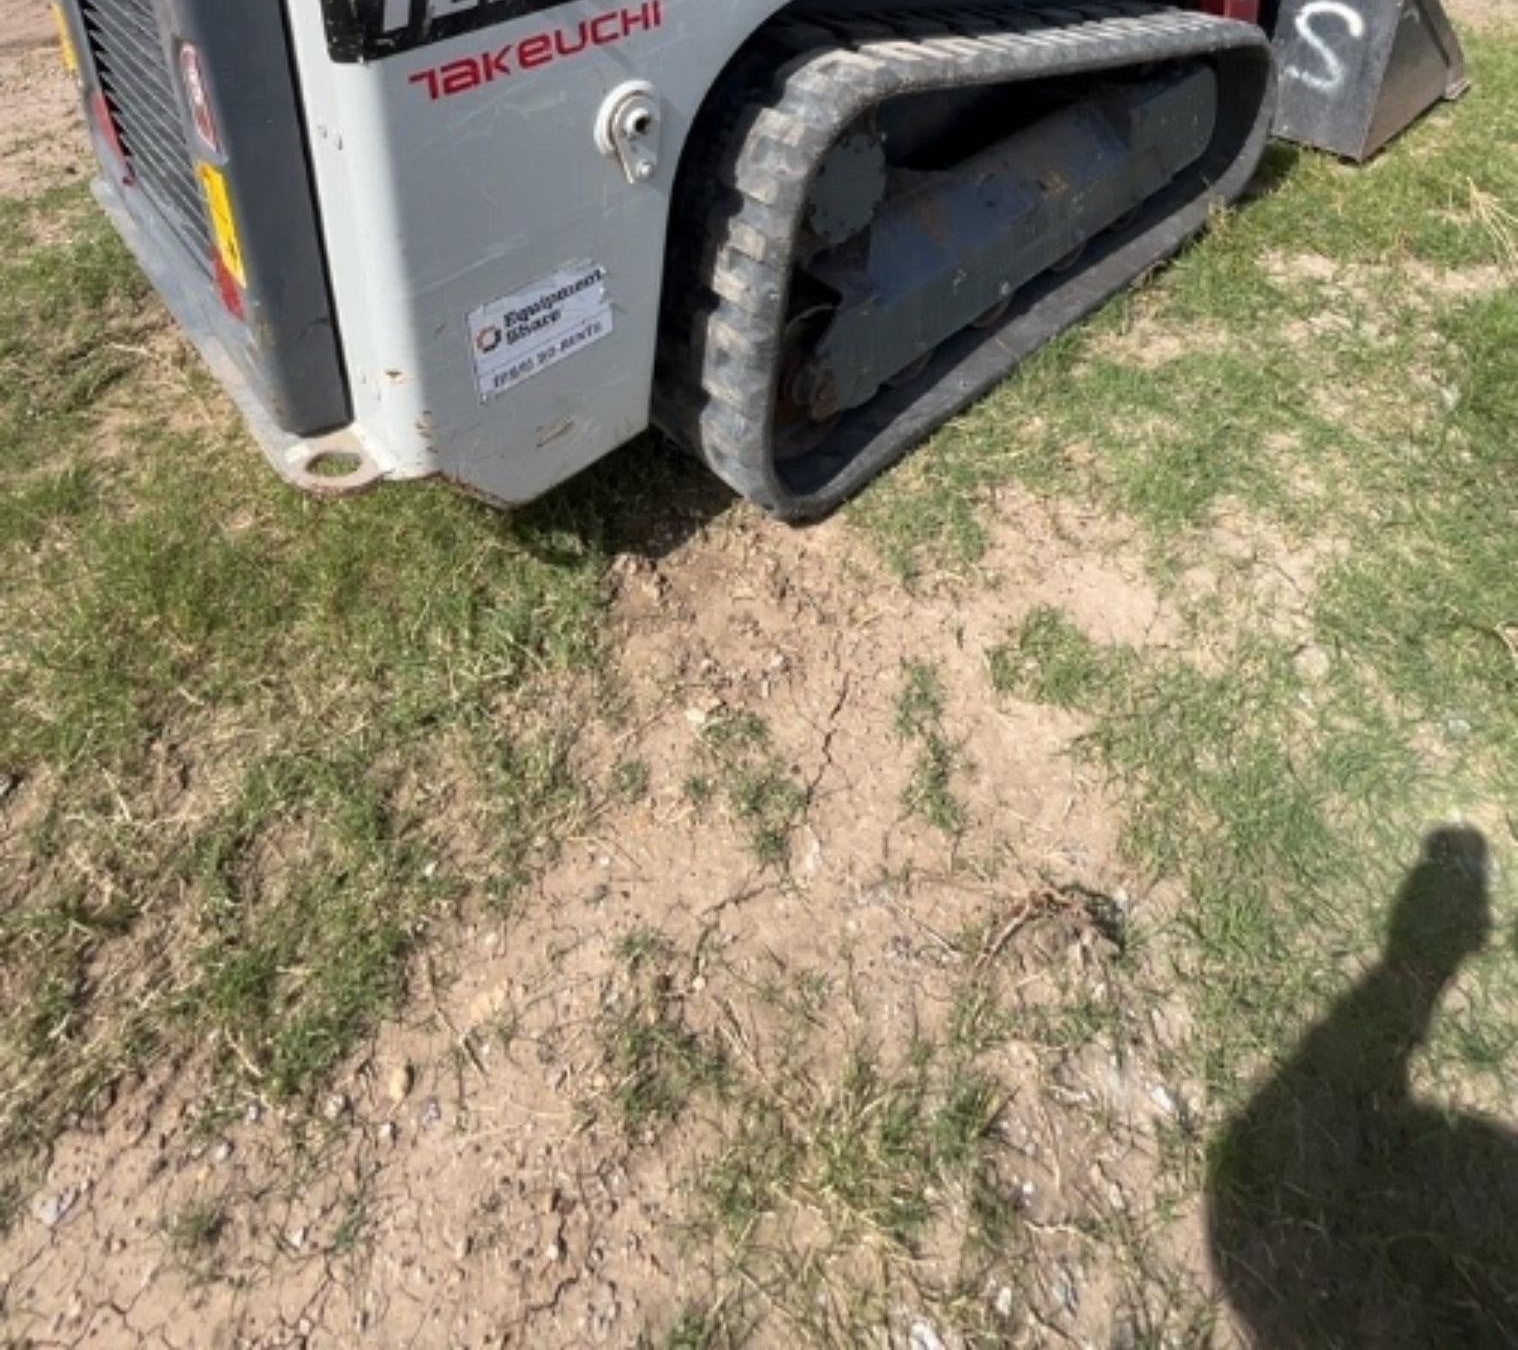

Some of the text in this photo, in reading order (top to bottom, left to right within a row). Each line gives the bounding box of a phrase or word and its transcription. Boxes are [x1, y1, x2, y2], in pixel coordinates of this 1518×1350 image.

[1284, 0, 1365, 92] S
[503, 267, 602, 327] Equipment
[506, 308, 561, 346] Share
